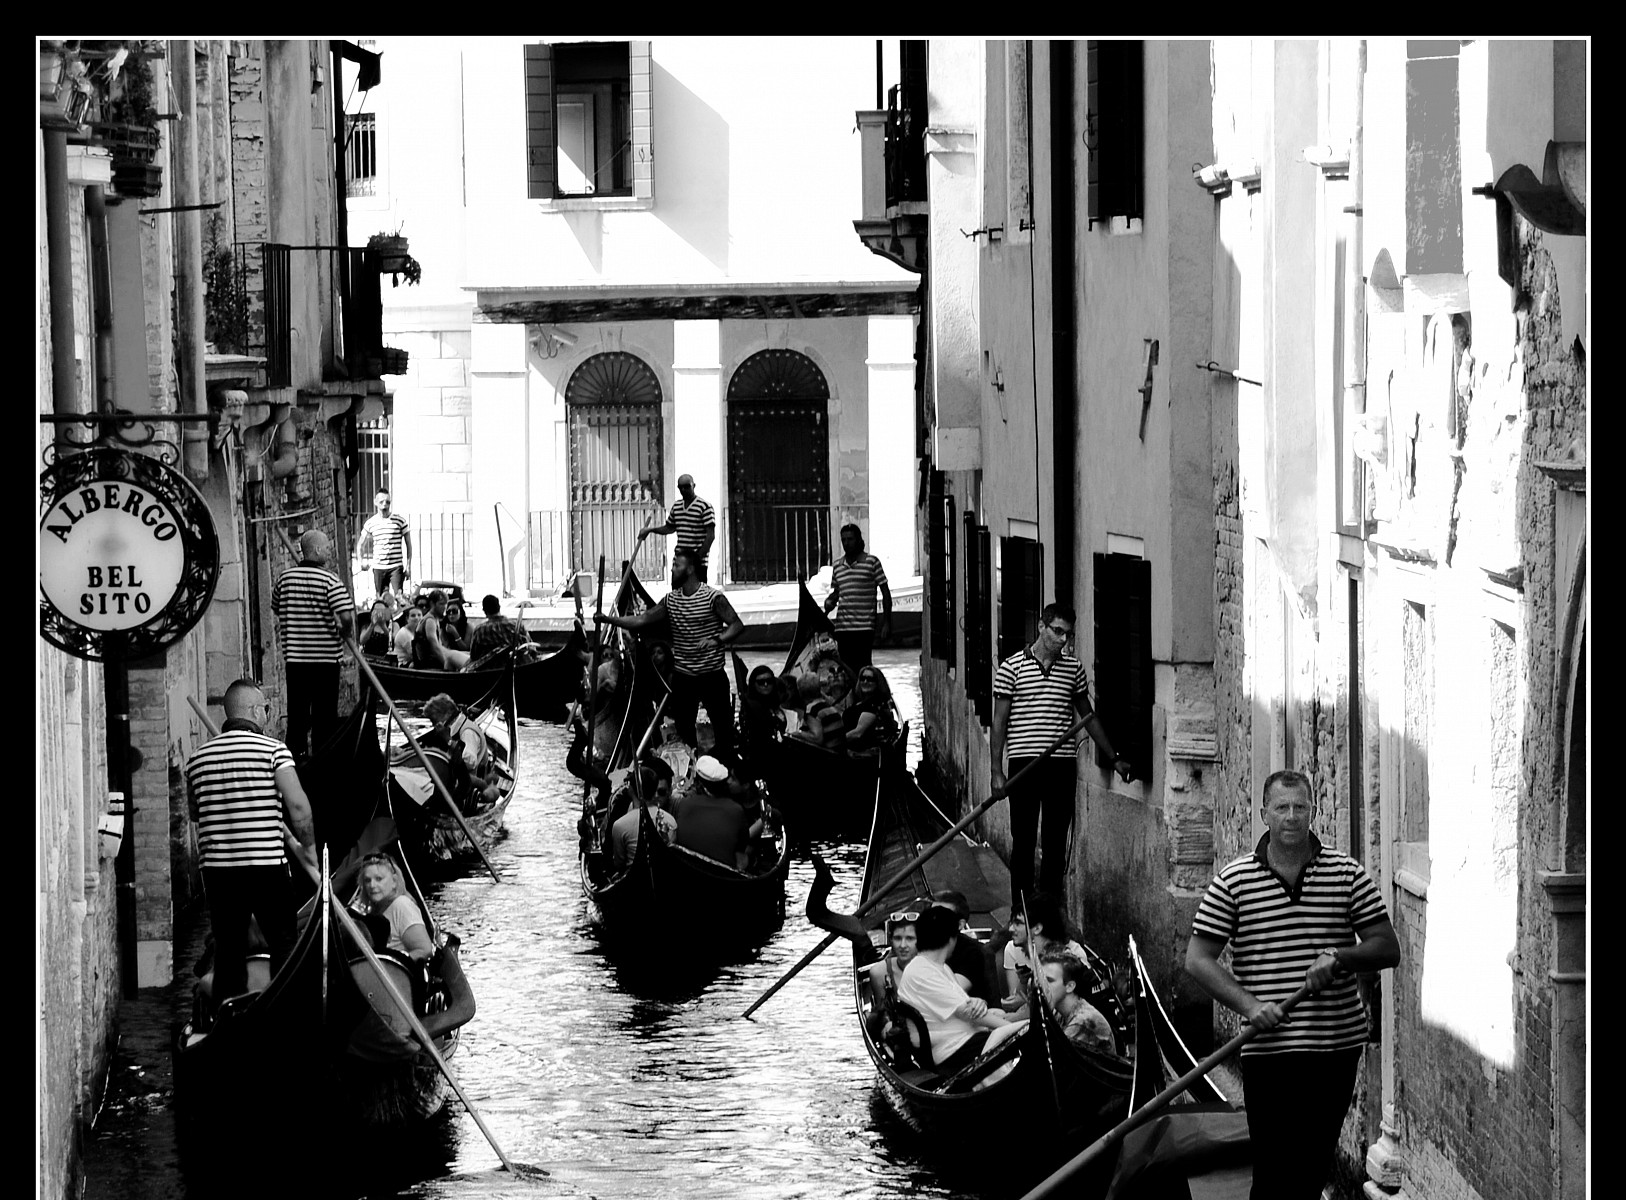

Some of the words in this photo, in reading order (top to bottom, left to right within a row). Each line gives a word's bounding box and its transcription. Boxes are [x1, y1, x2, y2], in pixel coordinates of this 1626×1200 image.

[47, 485, 177, 543] ALBERGO
[87, 566, 143, 588] BEL
[80, 592, 151, 615] SITO
